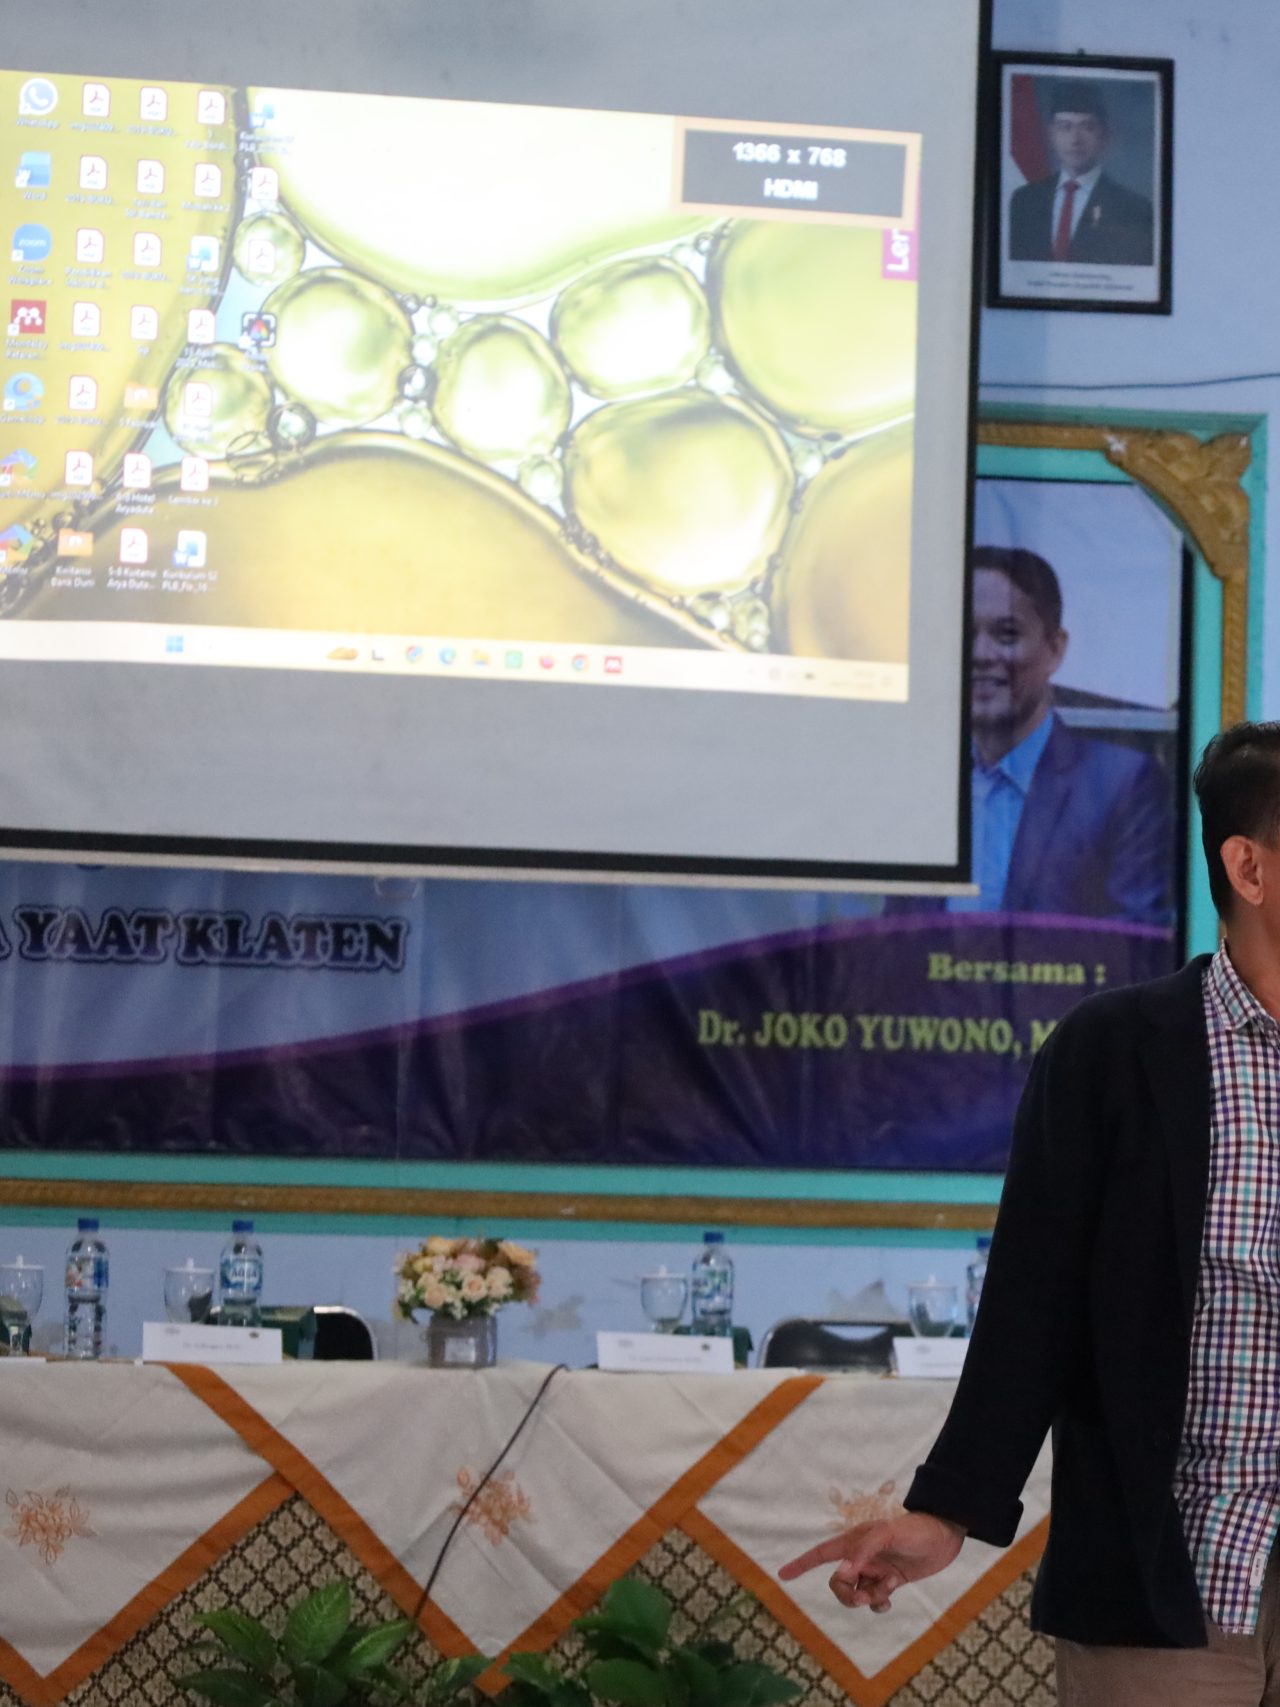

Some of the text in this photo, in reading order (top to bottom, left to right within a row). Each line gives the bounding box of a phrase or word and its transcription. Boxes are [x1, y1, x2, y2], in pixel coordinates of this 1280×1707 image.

[732, 142, 847, 168] 1366 x 768
[763, 178, 819, 200] HDMI
[177, 912, 408, 970] KLATEN
[928, 952, 1086, 985] Bersama
[698, 1008, 745, 1046] Dr.
[754, 1011, 849, 1049] JOKO
[857, 1013, 1022, 1060] YUWONO,
